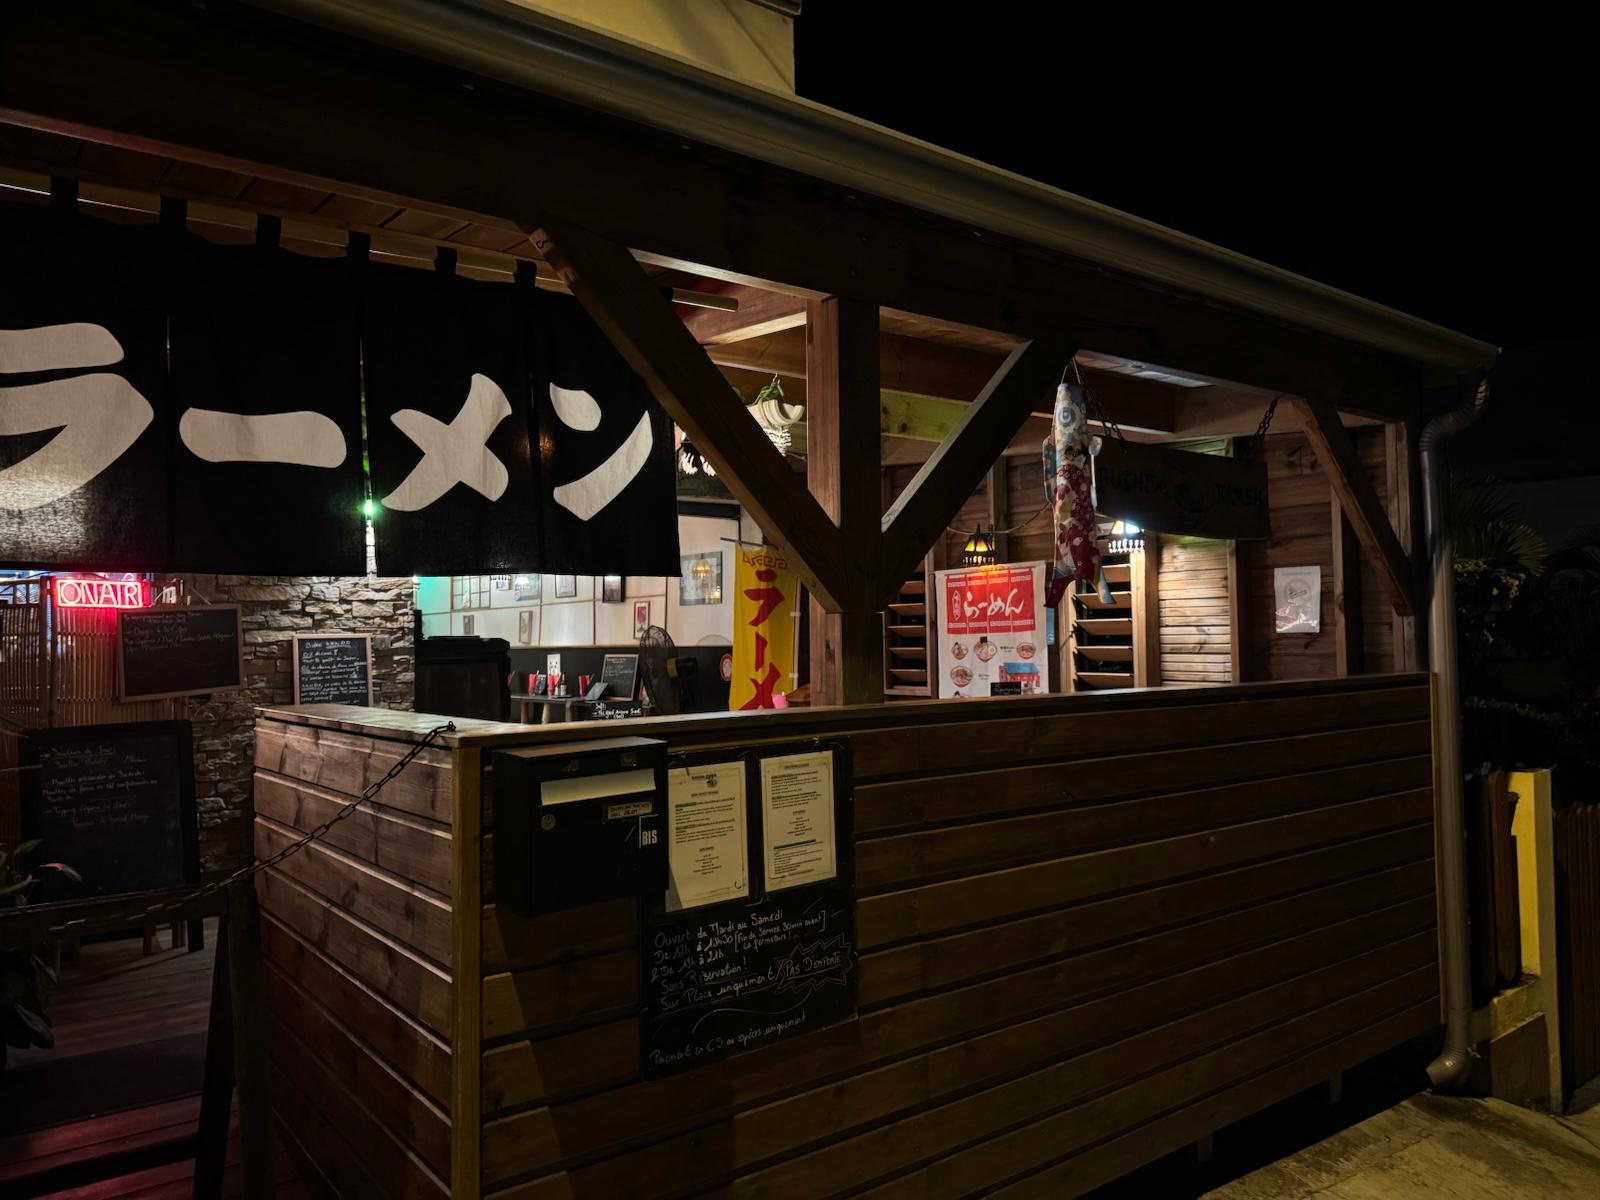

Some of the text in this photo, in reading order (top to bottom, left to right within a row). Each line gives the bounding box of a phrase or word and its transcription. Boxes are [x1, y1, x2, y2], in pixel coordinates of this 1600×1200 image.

[0, 321, 653, 522] ラーメン
[963, 588, 1025, 619] らーめん
[642, 830, 657, 846] BIS
[708, 920, 735, 936] Mardi
[737, 922, 748, 930] au
[750, 908, 784, 927] Samedi
[654, 950, 670, 964] De
[661, 966, 776, 1011] Sur Place uniquement
